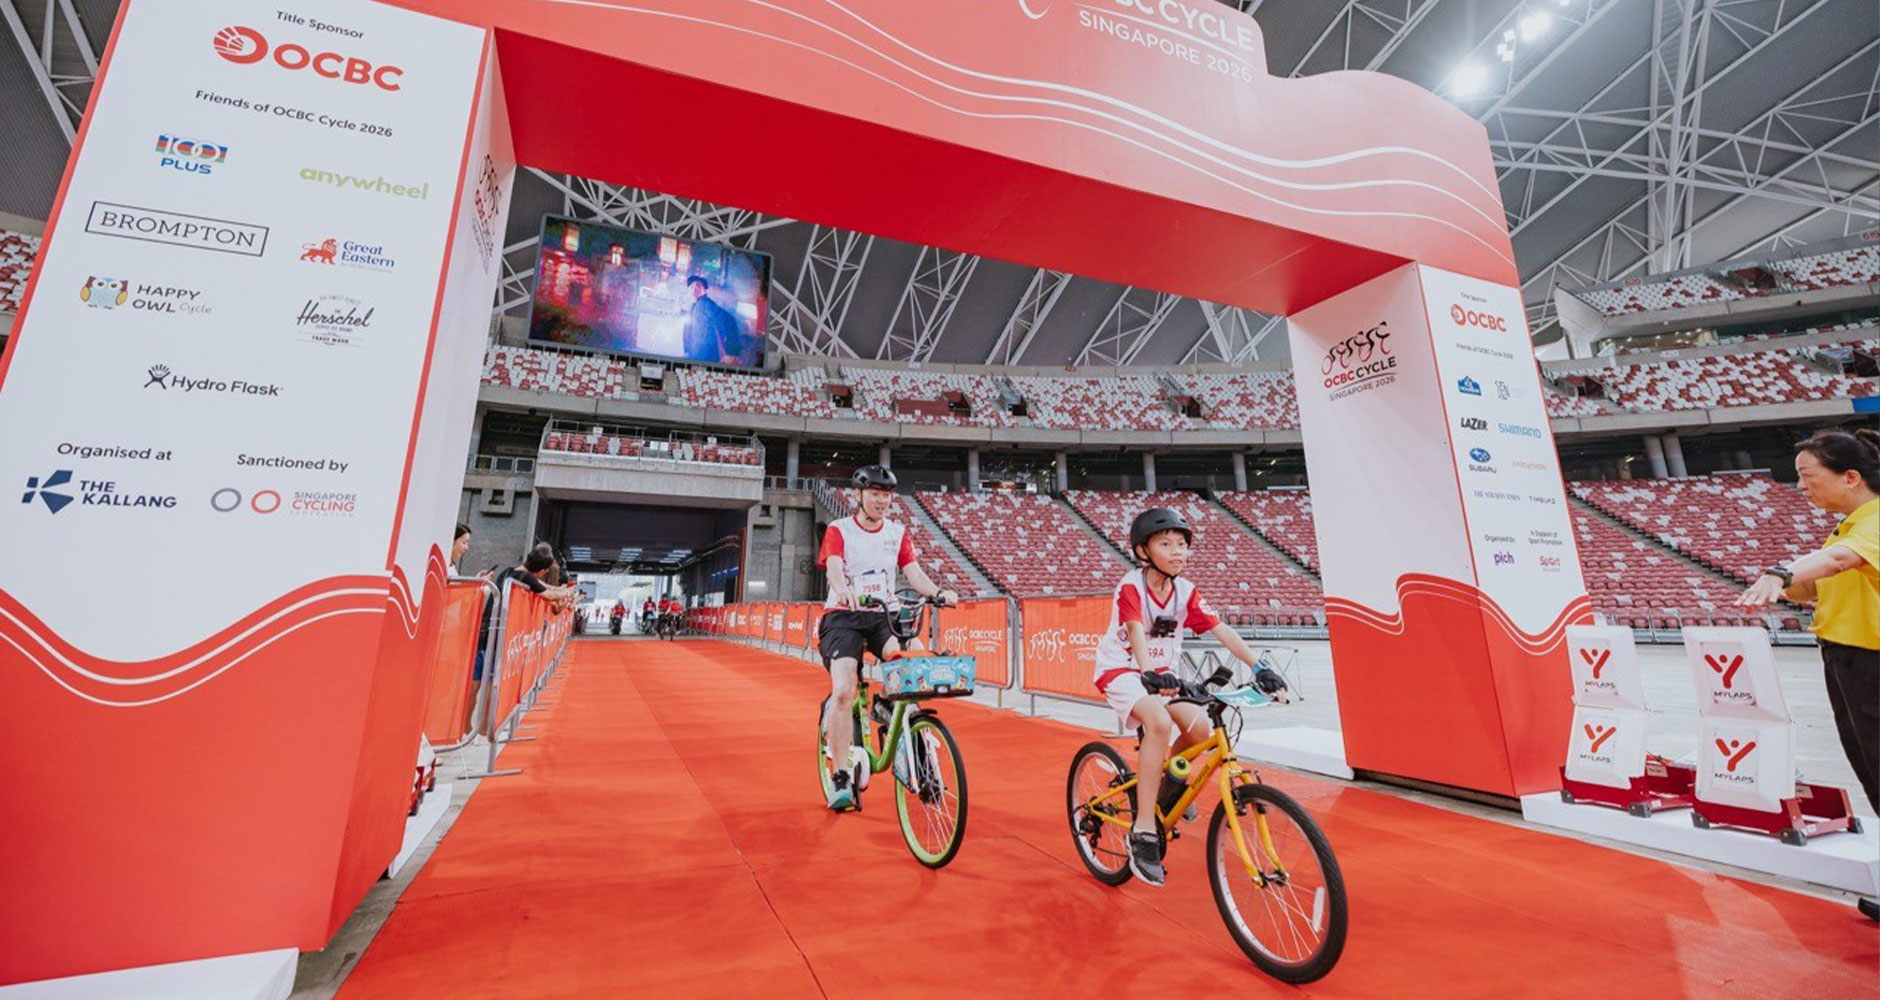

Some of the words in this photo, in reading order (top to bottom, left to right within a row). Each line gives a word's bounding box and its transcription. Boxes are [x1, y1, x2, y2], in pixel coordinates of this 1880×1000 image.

[276, 11, 305, 27] Title
[309, 18, 364, 40] Sponsor
[1159, 0, 1254, 50] CYCLE
[1079, 10, 1200, 65] SINGAPORE
[1206, 54, 1253, 82] 2026
[274, 43, 404, 91] OCBC
[195, 90, 250, 110] Friends
[254, 102, 270, 114] of
[273, 106, 315, 123] OCBC
[318, 115, 356, 132] Cycle
[360, 123, 394, 137] 2026
[161, 157, 212, 174] PLUS
[299, 165, 430, 200] anywheel
[100, 211, 256, 247] BROMPTON
[343, 241, 383, 255] Great
[341, 251, 396, 268] Eastern
[137, 284, 201, 300] HAPPY
[132, 298, 176, 313] OWL
[297, 299, 375, 327] Herschel
[1467, 310, 1507, 332] OCBC
[1324, 370, 1355, 388] OCBC
[1356, 356, 1397, 378] CYCLE
[171, 375, 227, 394] Hydro
[231, 380, 280, 396] Flask
[1329, 384, 1373, 402] SINGAPORE
[1375, 376, 1396, 388] 2026
[1461, 417, 1488, 431] LAZER
[1498, 423, 1542, 438] SHIMANO
[57, 443, 151, 460] Organised
[156, 448, 172, 461] at
[237, 453, 325, 470] Sanctioned
[329, 458, 349, 474] by
[80, 480, 116, 493] THE
[83, 492, 178, 509] KALLANG
[294, 491, 357, 501] SINGAPORE
[292, 500, 355, 512] CYCLING
[1494, 551, 1515, 566] pich
[1069, 633, 1090, 645] OCBC
[1713, 691, 1753, 699] MYLAPS
[1580, 754, 1611, 763] MYLAPS
[1714, 773, 1754, 783] MYLAPS
